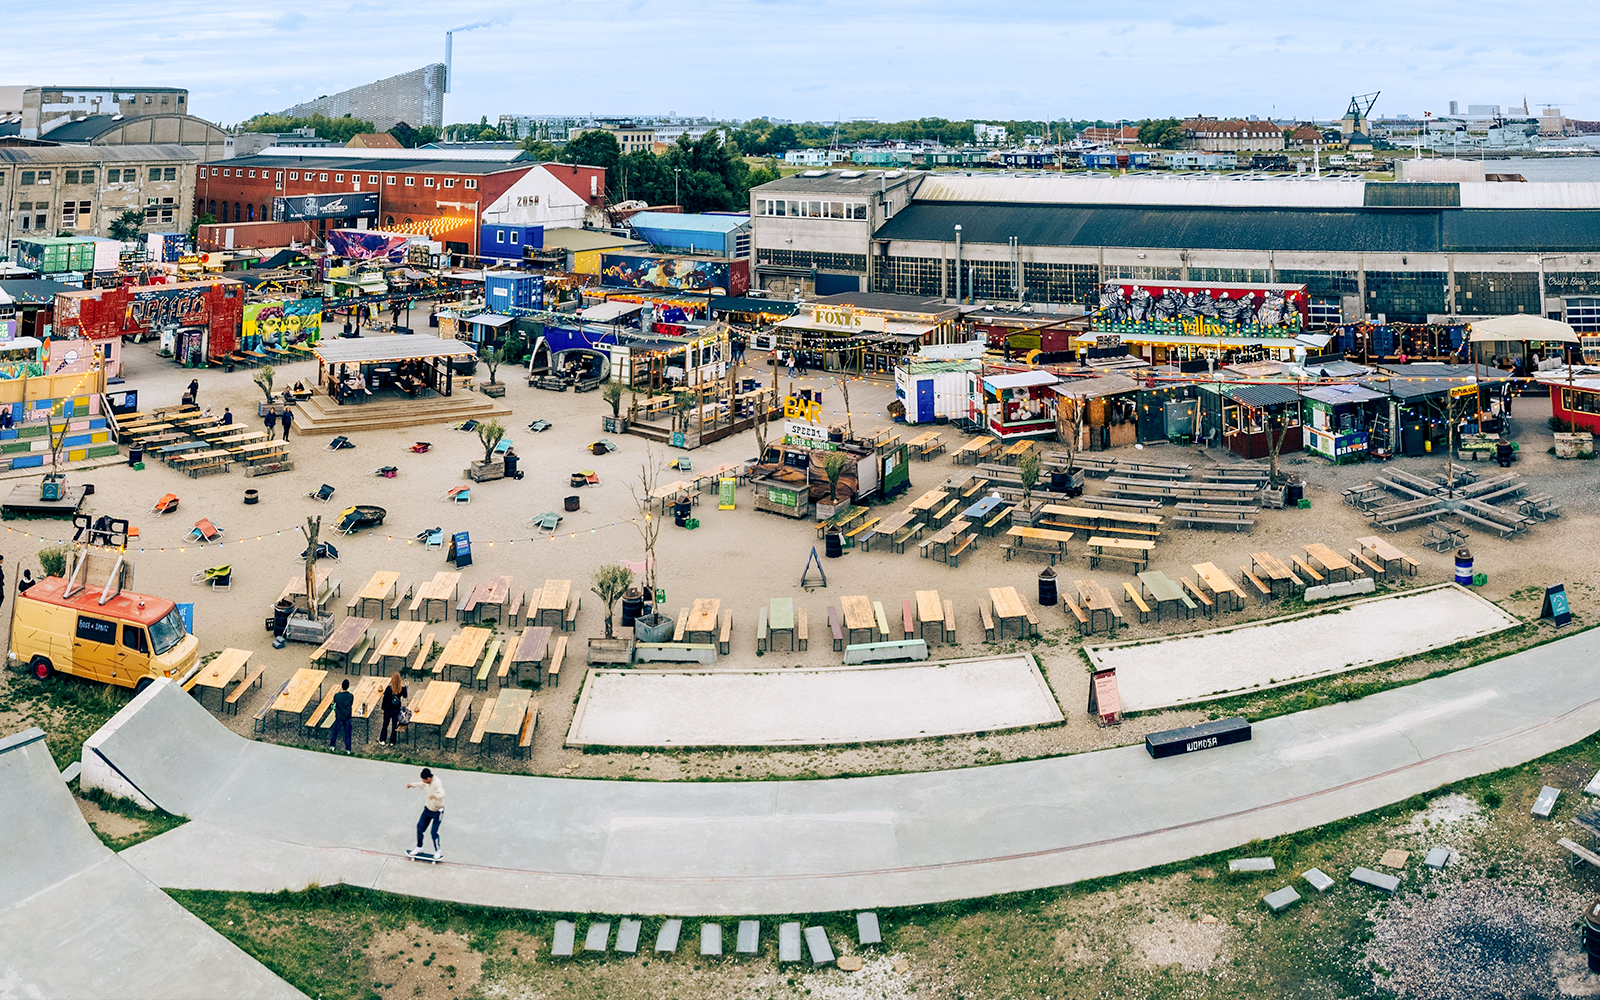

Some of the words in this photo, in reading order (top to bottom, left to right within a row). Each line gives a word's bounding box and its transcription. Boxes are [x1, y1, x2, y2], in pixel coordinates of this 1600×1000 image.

[1547, 276, 1569, 289] Craft
[1570, 276, 1587, 286] Beer
[784, 396, 821, 423] BAR
[791, 437, 806, 446] BEER
